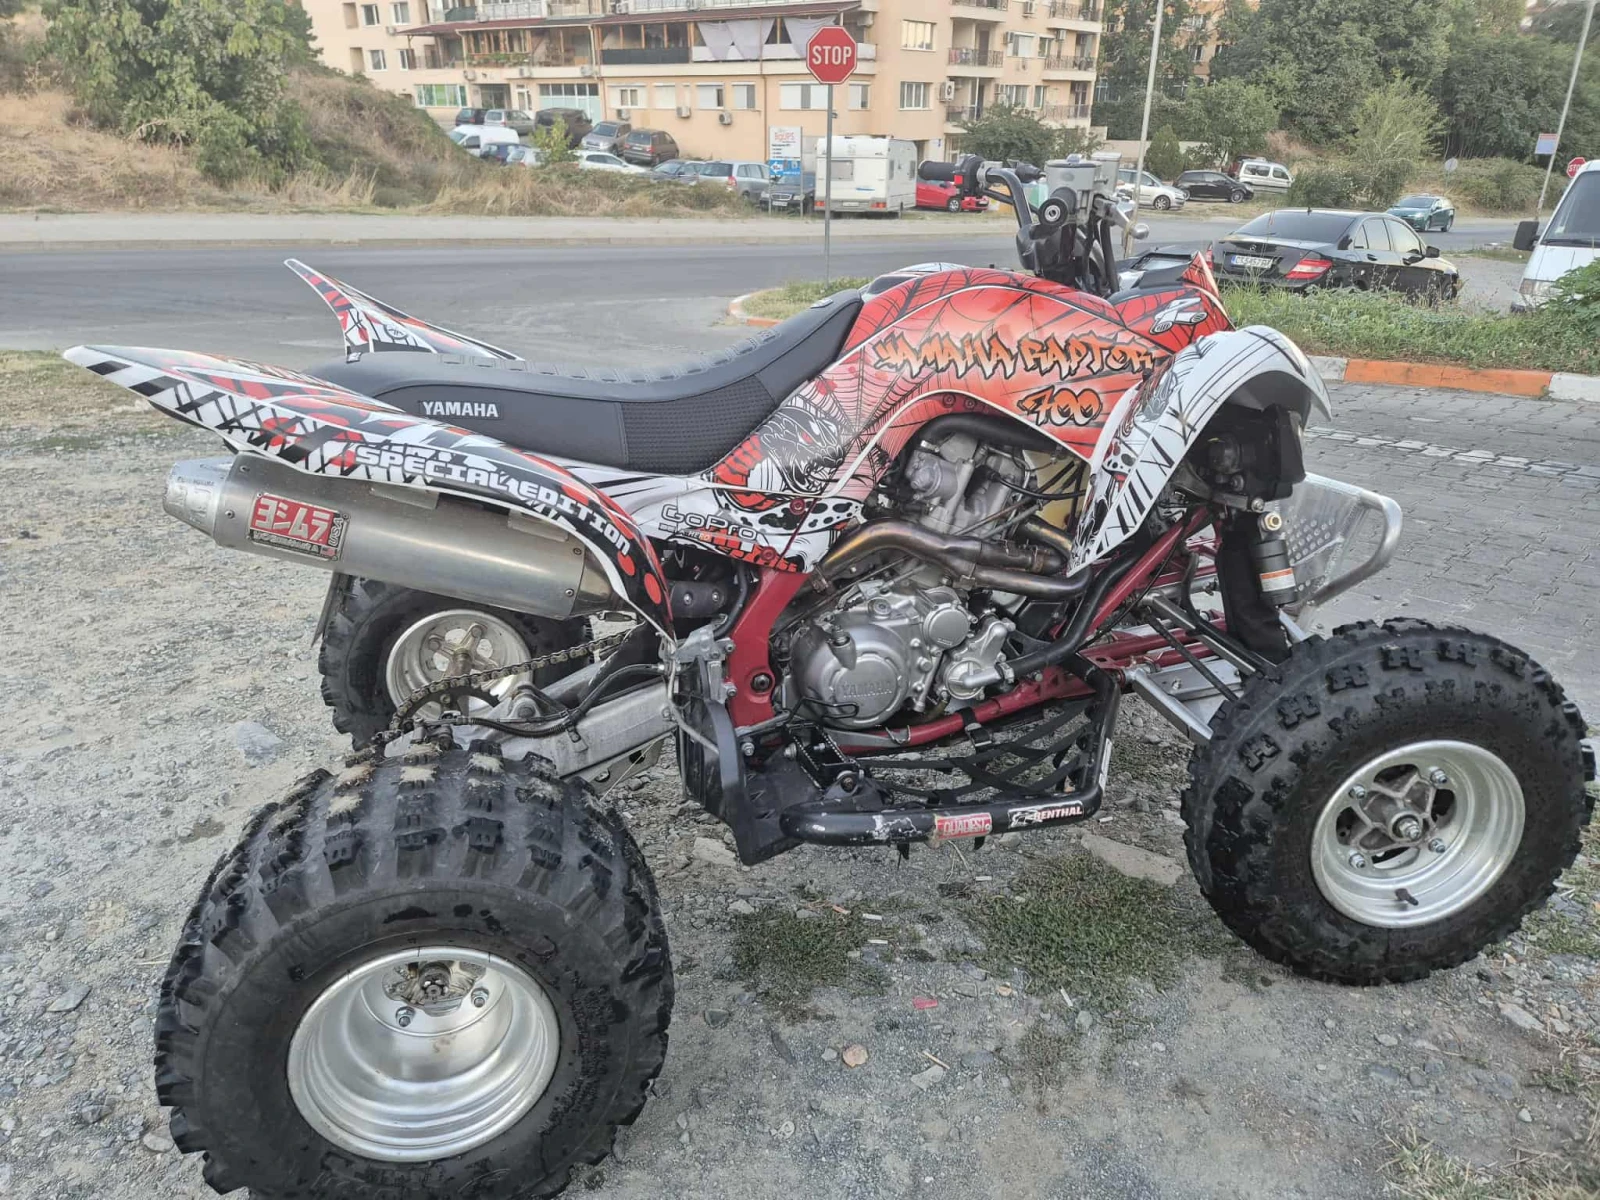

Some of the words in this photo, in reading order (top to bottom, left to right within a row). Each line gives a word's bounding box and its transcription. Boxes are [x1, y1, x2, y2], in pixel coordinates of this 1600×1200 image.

[812, 45, 851, 65] STOP
[872, 331, 1017, 380] YAMAHA
[1018, 331, 1155, 380] RAPTOR
[422, 401, 499, 418] YAMAHA
[1016, 385, 1103, 427] 700
[355, 445, 509, 492] SPECIAL
[519, 480, 631, 556] EDITION
[254, 497, 331, 542] ヨシムラ
[328, 517, 344, 547] USA
[1033, 806, 1083, 822] RENTHAL
